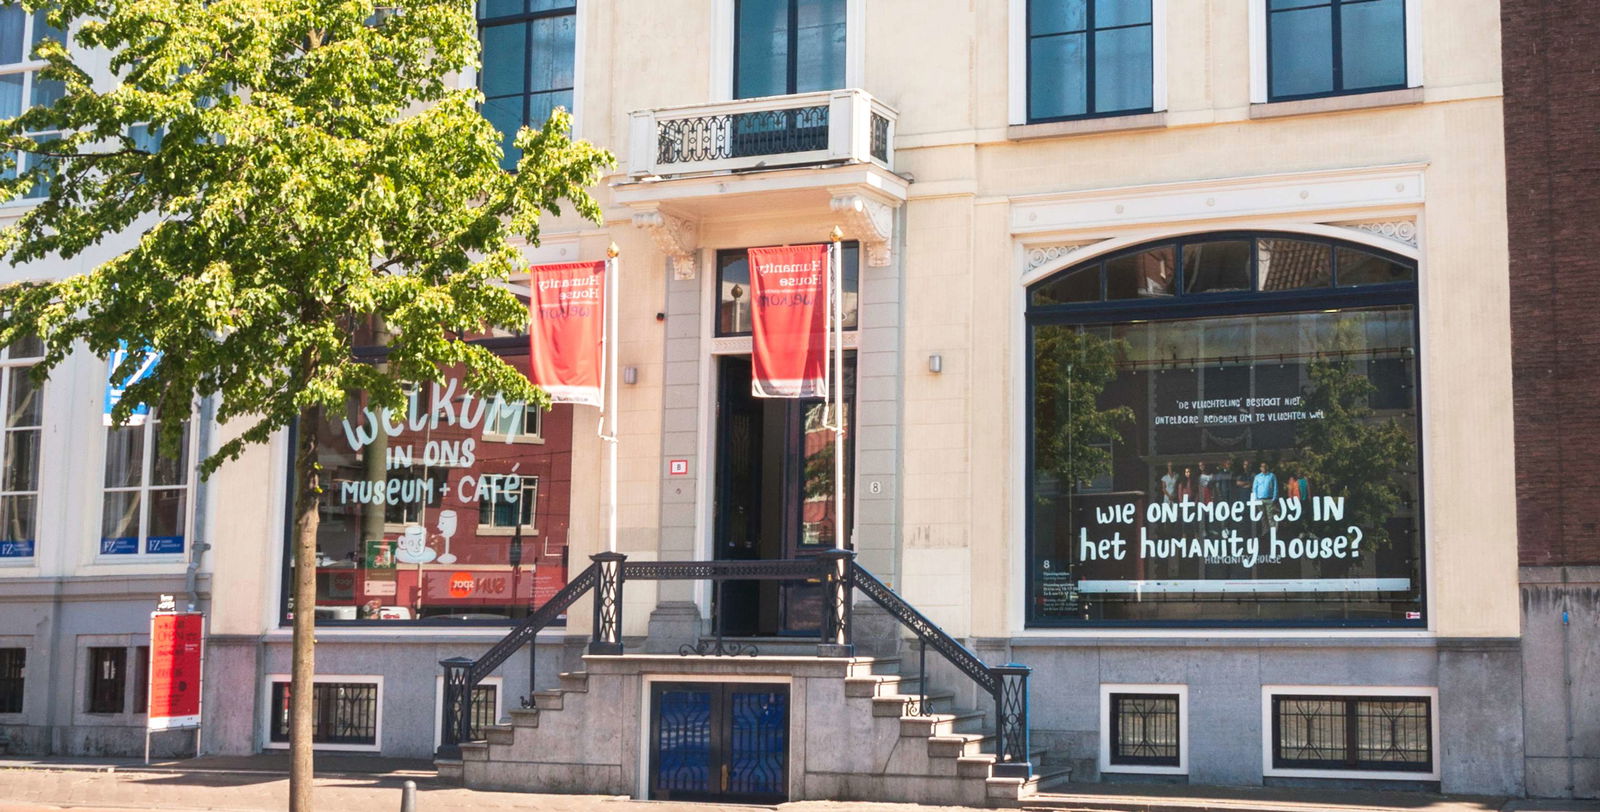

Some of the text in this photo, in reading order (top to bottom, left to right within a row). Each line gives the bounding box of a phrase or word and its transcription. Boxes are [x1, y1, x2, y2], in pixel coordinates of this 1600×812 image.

[1246, 397, 1281, 407] BESTAAT
[1155, 414, 1199, 425] ONTELBARE
[1203, 414, 1238, 424] REDENEN
[1239, 414, 1252, 423] OM
[1256, 413, 1265, 422] TE
[1267, 412, 1306, 422] VLUCHTEN
[386, 437, 476, 471] IN ONS
[341, 478, 434, 505] MUSEUM
[439, 482, 450, 497] +
[872, 482, 879, 493] 8
[103, 540, 116, 553] FZ
[149, 539, 161, 551] FZ
[1080, 526, 1127, 561] het
[1269, 525, 1363, 560] house?
[1043, 559, 1050, 569] 8
